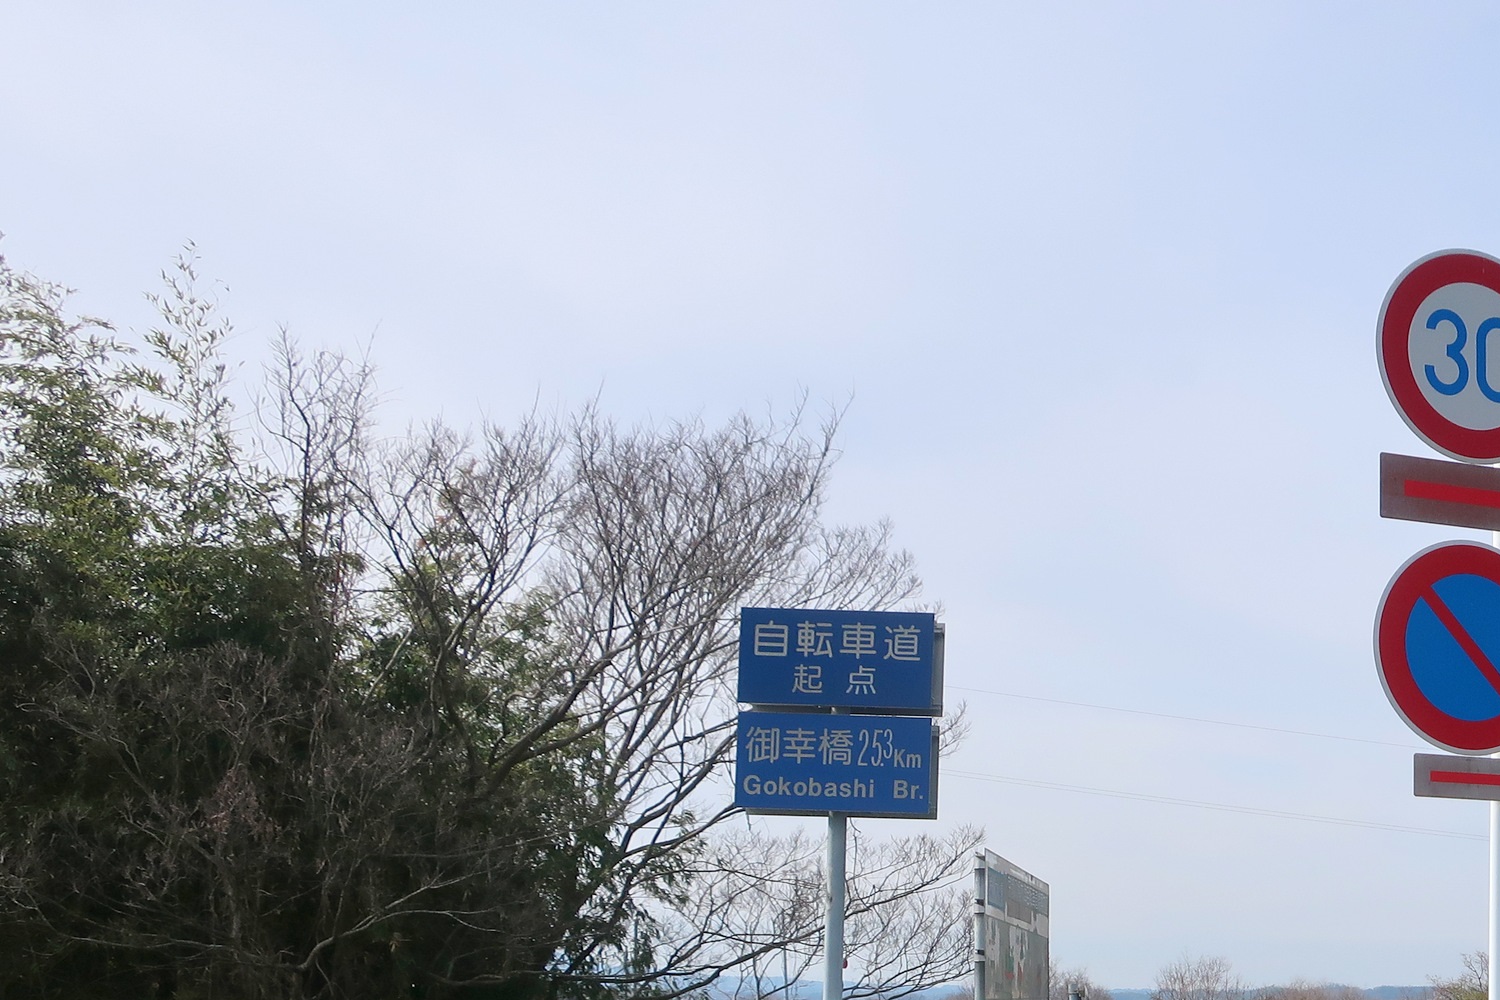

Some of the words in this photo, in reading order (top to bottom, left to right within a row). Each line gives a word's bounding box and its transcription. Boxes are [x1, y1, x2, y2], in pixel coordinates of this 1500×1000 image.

[754, 620, 921, 662] 自転車道
[743, 774, 875, 799] Gokobashi
[893, 779, 924, 800] Br.
